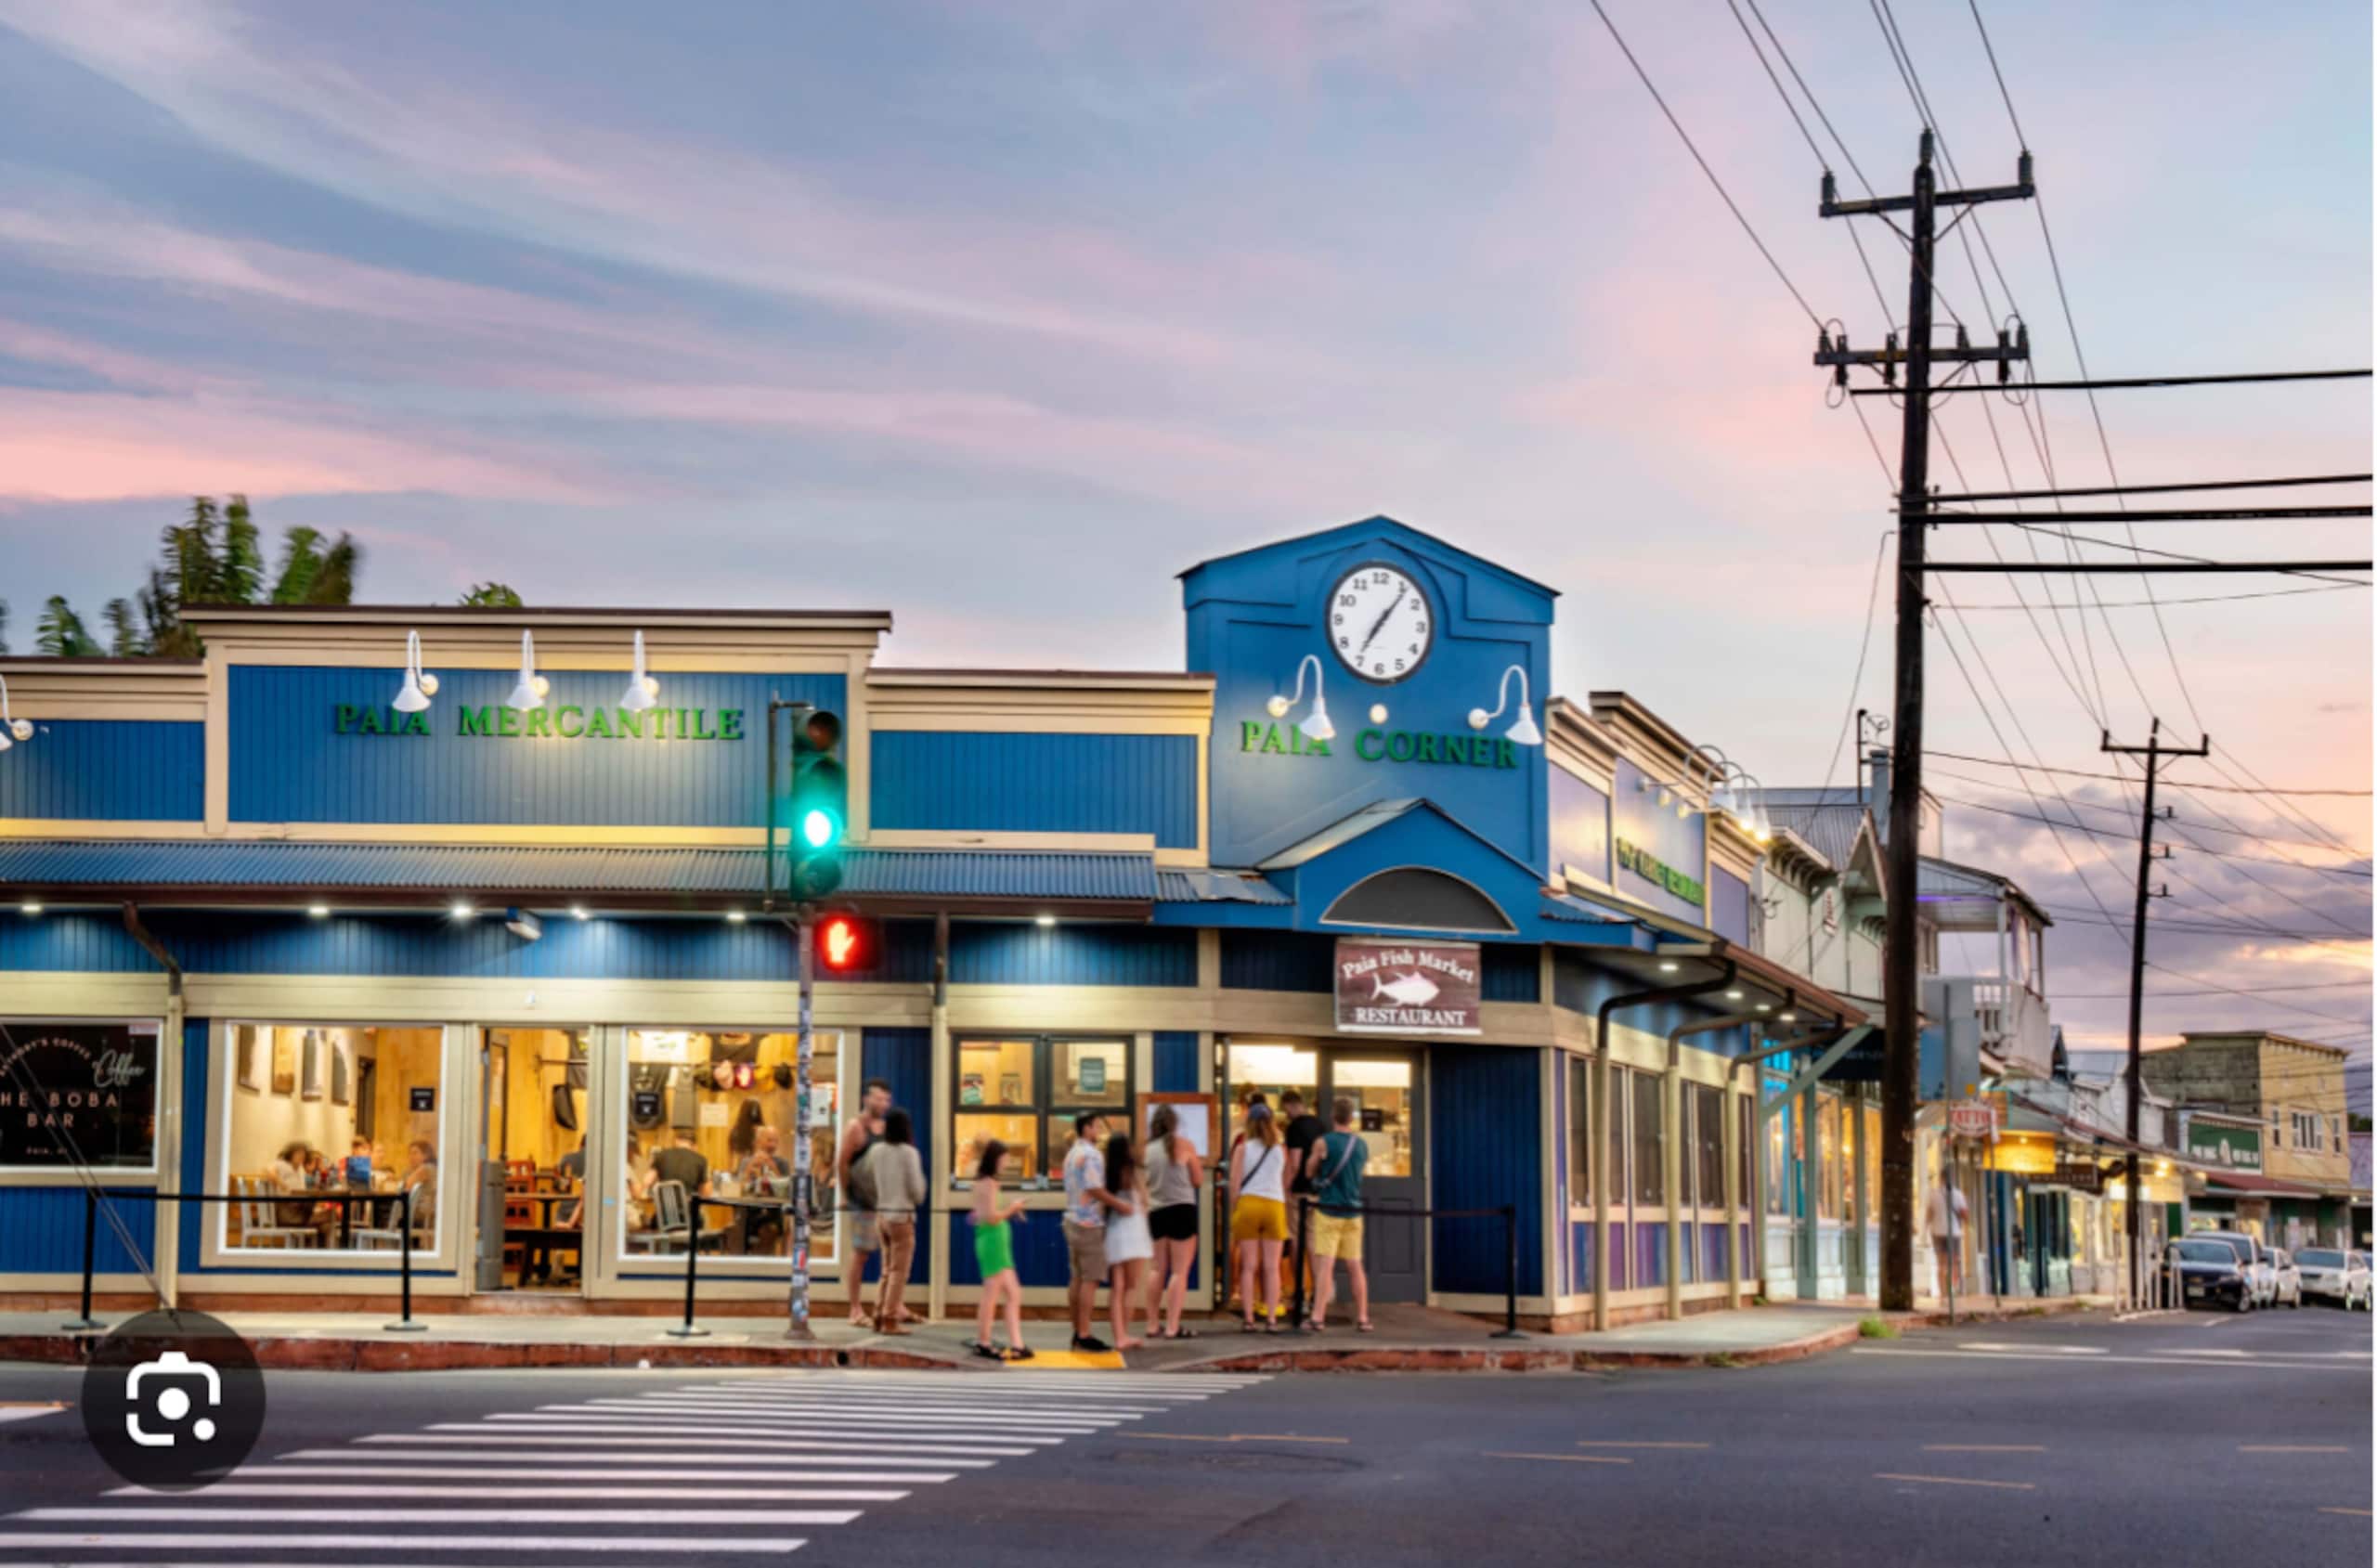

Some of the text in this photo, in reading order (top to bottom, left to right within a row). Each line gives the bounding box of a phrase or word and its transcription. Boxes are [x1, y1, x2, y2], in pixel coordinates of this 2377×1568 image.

[1353, 578, 1368, 591] 11
[1372, 572, 1390, 585] 12
[1339, 594, 1357, 607] 10
[1410, 599, 1421, 611] 2
[1334, 614, 1344, 626] 9
[1416, 621, 1426, 633] 3
[1340, 637, 1349, 648] 8
[1409, 642, 1418, 654] 4
[1356, 654, 1364, 667] 7
[1395, 658, 1405, 670] 5
[1374, 663, 1384, 675] 6
[334, 704, 745, 740] PAIA MERCANTILE
[1355, 728, 1518, 769] CORNER
[1343, 949, 1474, 982] Paia Fish Market
[1355, 1007, 1467, 1026] RESTAURANT
[0, 1092, 119, 1108] HE BOBA
[27, 1112, 74, 1128] BAR
